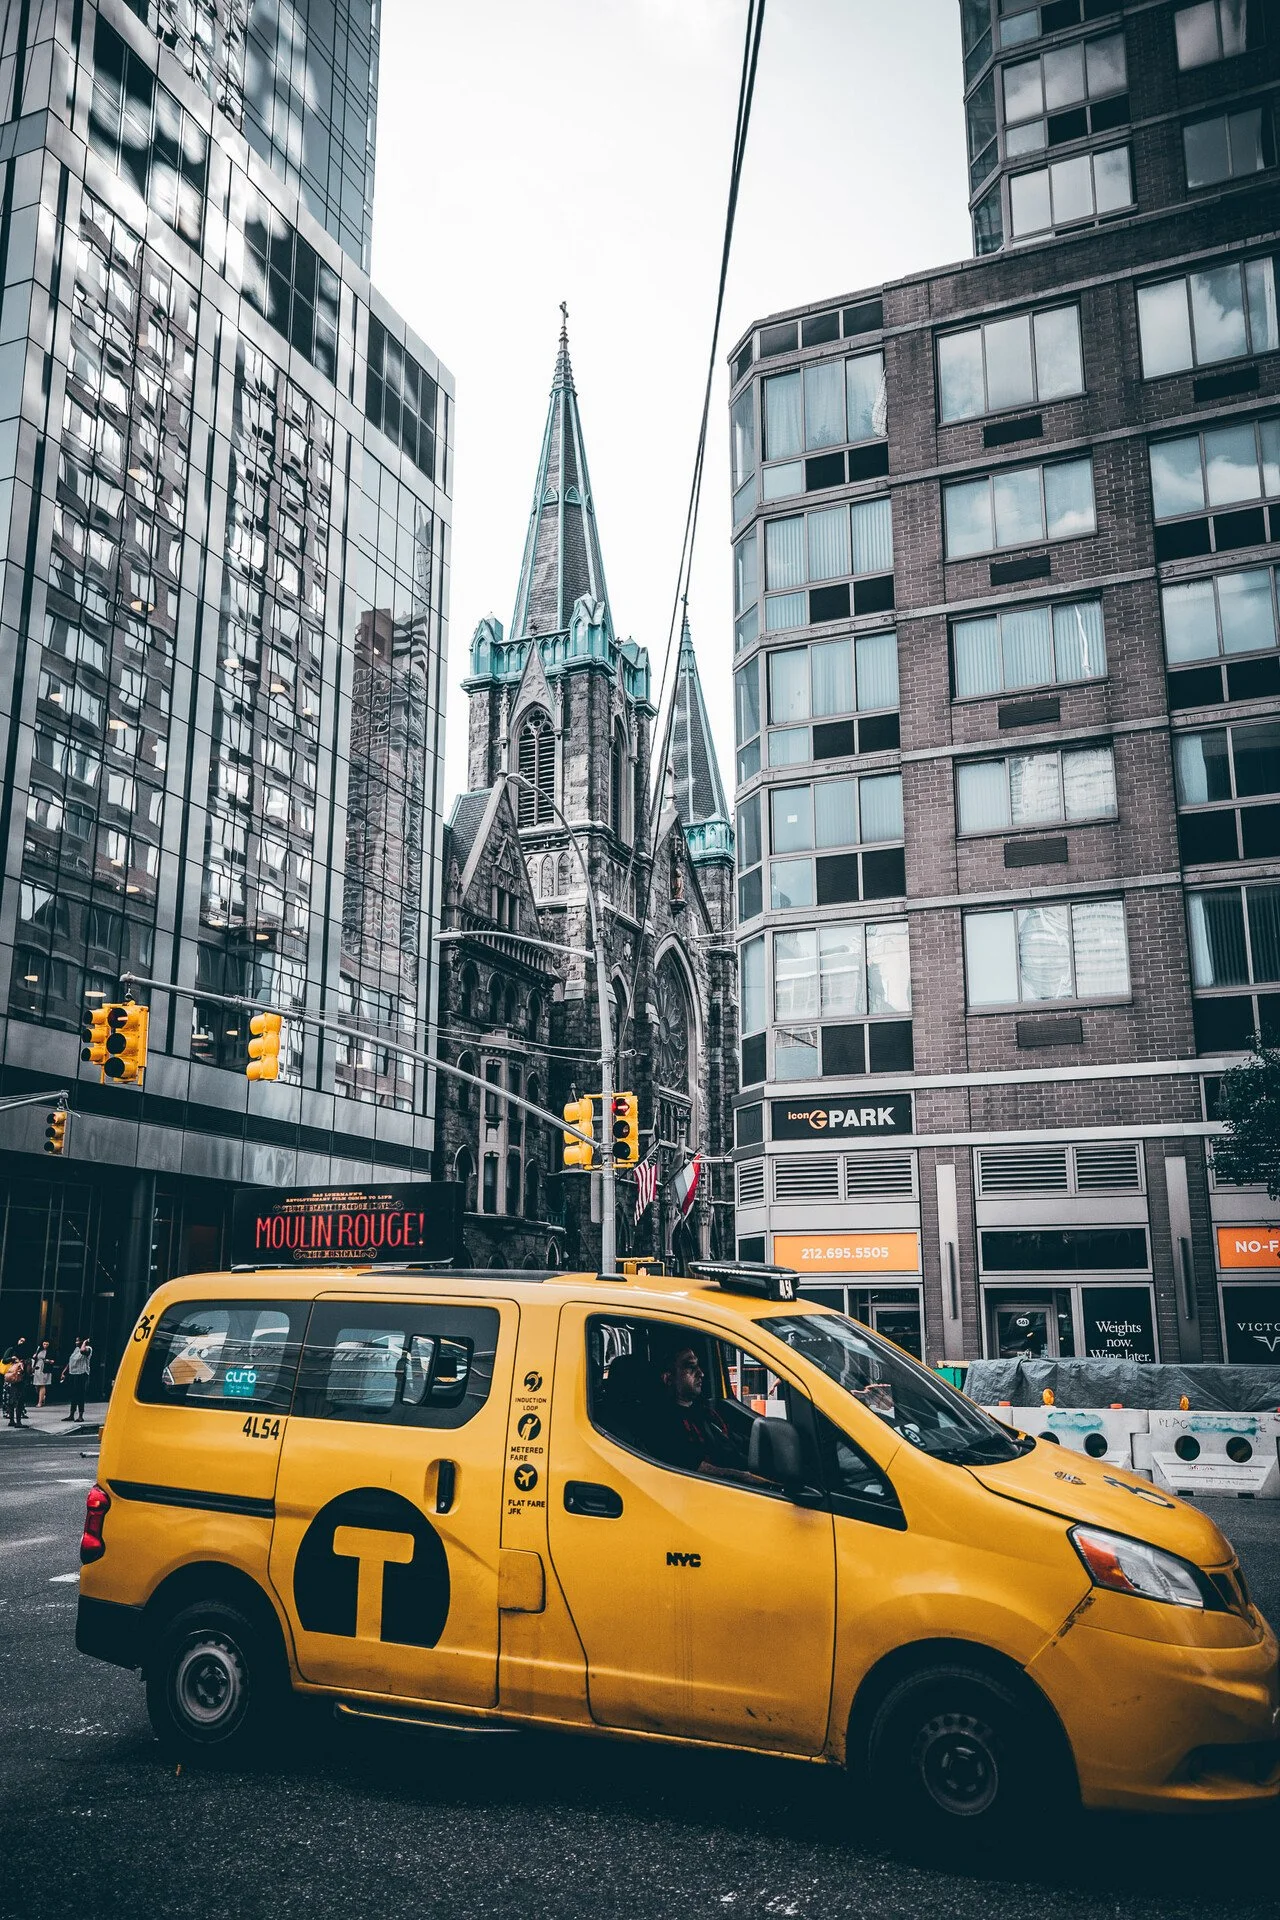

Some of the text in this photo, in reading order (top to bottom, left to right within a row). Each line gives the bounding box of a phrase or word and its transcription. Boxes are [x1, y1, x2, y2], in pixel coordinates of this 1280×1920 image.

[828, 1106, 896, 1128] PARK
[256, 1212, 425, 1249] MOULIN ROUGE!
[801, 1247, 889, 1259] 212.695.5505
[1095, 1320, 1142, 1336] Weights
[1106, 1339, 1133, 1347] now.
[1125, 1349, 1152, 1362] later.
[225, 1371, 257, 1383] curb
[242, 1416, 280, 1440] 4L54
[510, 1446, 544, 1454] METERED
[507, 1499, 546, 1508] FLAT FARE
[507, 1507, 522, 1515] JFK
[666, 1552, 702, 1567] NYC
[333, 1525, 415, 1642] T
